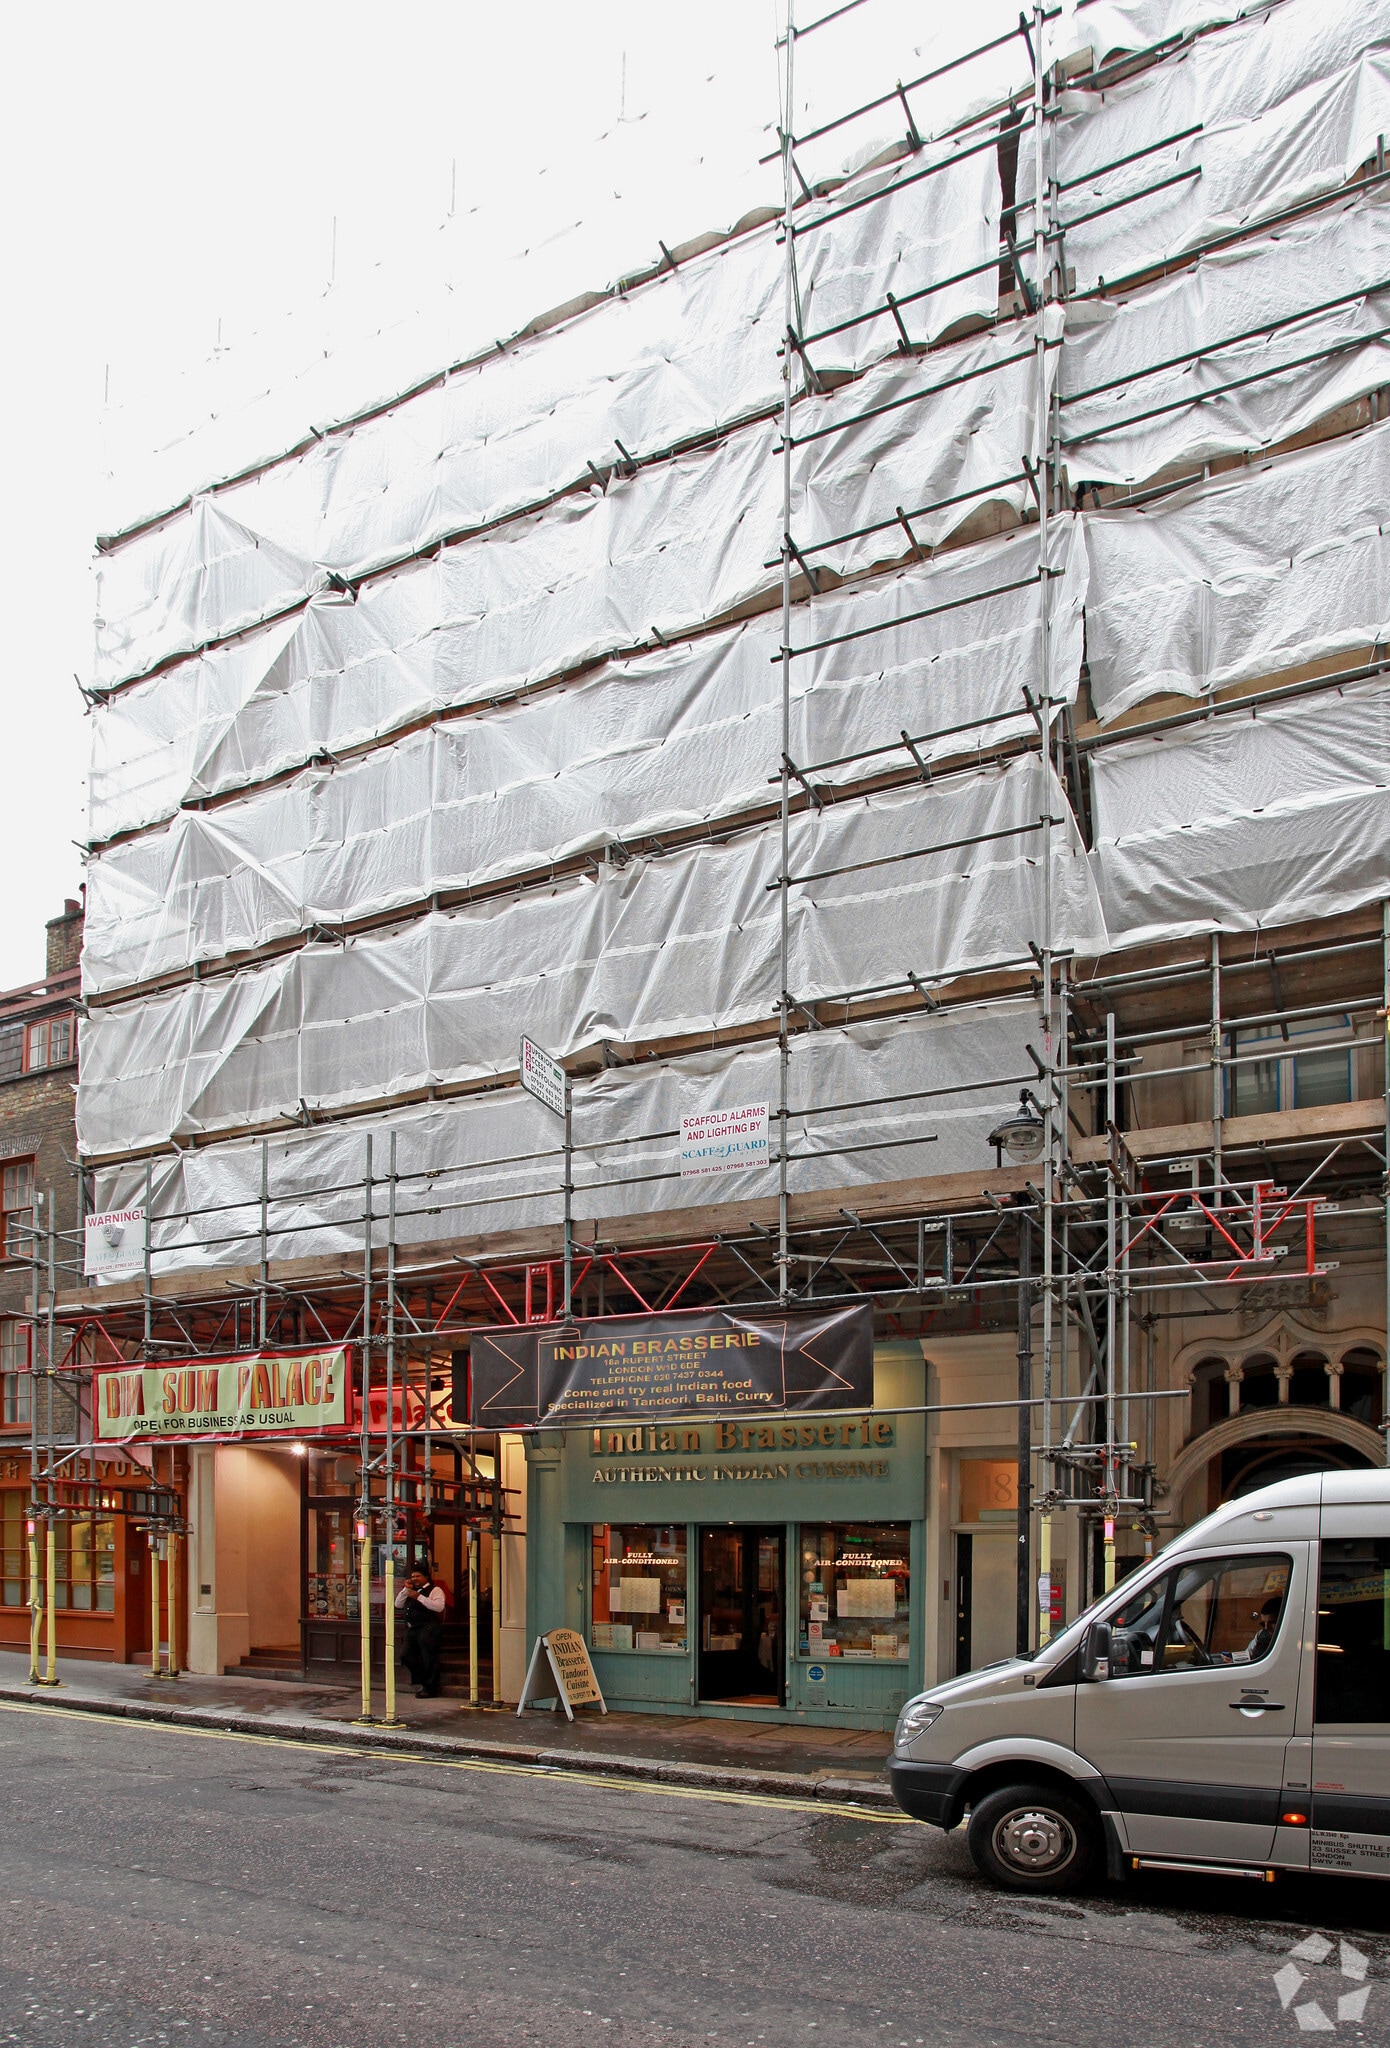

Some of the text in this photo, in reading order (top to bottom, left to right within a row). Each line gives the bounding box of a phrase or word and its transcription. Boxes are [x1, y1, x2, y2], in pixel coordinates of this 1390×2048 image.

[526, 1041, 553, 1069] SUPERIOR
[526, 1051, 546, 1072] ACCESS
[526, 1060, 562, 1096] SCAFFOLDING
[683, 1106, 766, 1128] SCAFFOLD ALARMS
[687, 1121, 761, 1141] AND LIGHTING BY
[728, 1140, 766, 1152] GUARD
[88, 1210, 144, 1227] WARNING!
[554, 1332, 761, 1360] INDIAN BRASSERIE
[622, 1356, 664, 1364] RUPERT
[667, 1352, 708, 1361] STREET
[609, 1366, 654, 1374] LONDON
[656, 1363, 678, 1372] W1D
[590, 1375, 650, 1385] TELEPHONE
[672, 1371, 695, 1380] 7437
[698, 1370, 724, 1378] 0344
[106, 1357, 335, 1418] DIM SUM PALACE
[564, 1379, 752, 1398] Come and try real Indian food
[548, 1392, 774, 1412] Specialized in Tandoori, Balti, Curry
[165, 1418, 186, 1429] FOR
[188, 1415, 239, 1428] BUSINESS
[240, 1414, 255, 1426] AS
[259, 1412, 296, 1424] USUAL
[593, 1416, 892, 1453] Indian Brasserie
[592, 1460, 890, 1483] AUTHENTIC INDIAN CUISINE
[984, 1473, 1012, 1503] 18
[1018, 1535, 1026, 1544] 4
[556, 1632, 572, 1641] OPEN
[552, 1640, 582, 1656] INDIAN
[556, 1653, 586, 1668] Brasserie
[561, 1666, 589, 1680] Tandoori
[566, 1678, 590, 1690] Cuisine
[1312, 1840, 1344, 1848] MINIBUS
[1348, 1842, 1384, 1852] SHUTTLE
[1325, 1846, 1356, 1855] SUSSEX
[1360, 1850, 1390, 1858] STREET
[1312, 1852, 1345, 1860] LONDON
